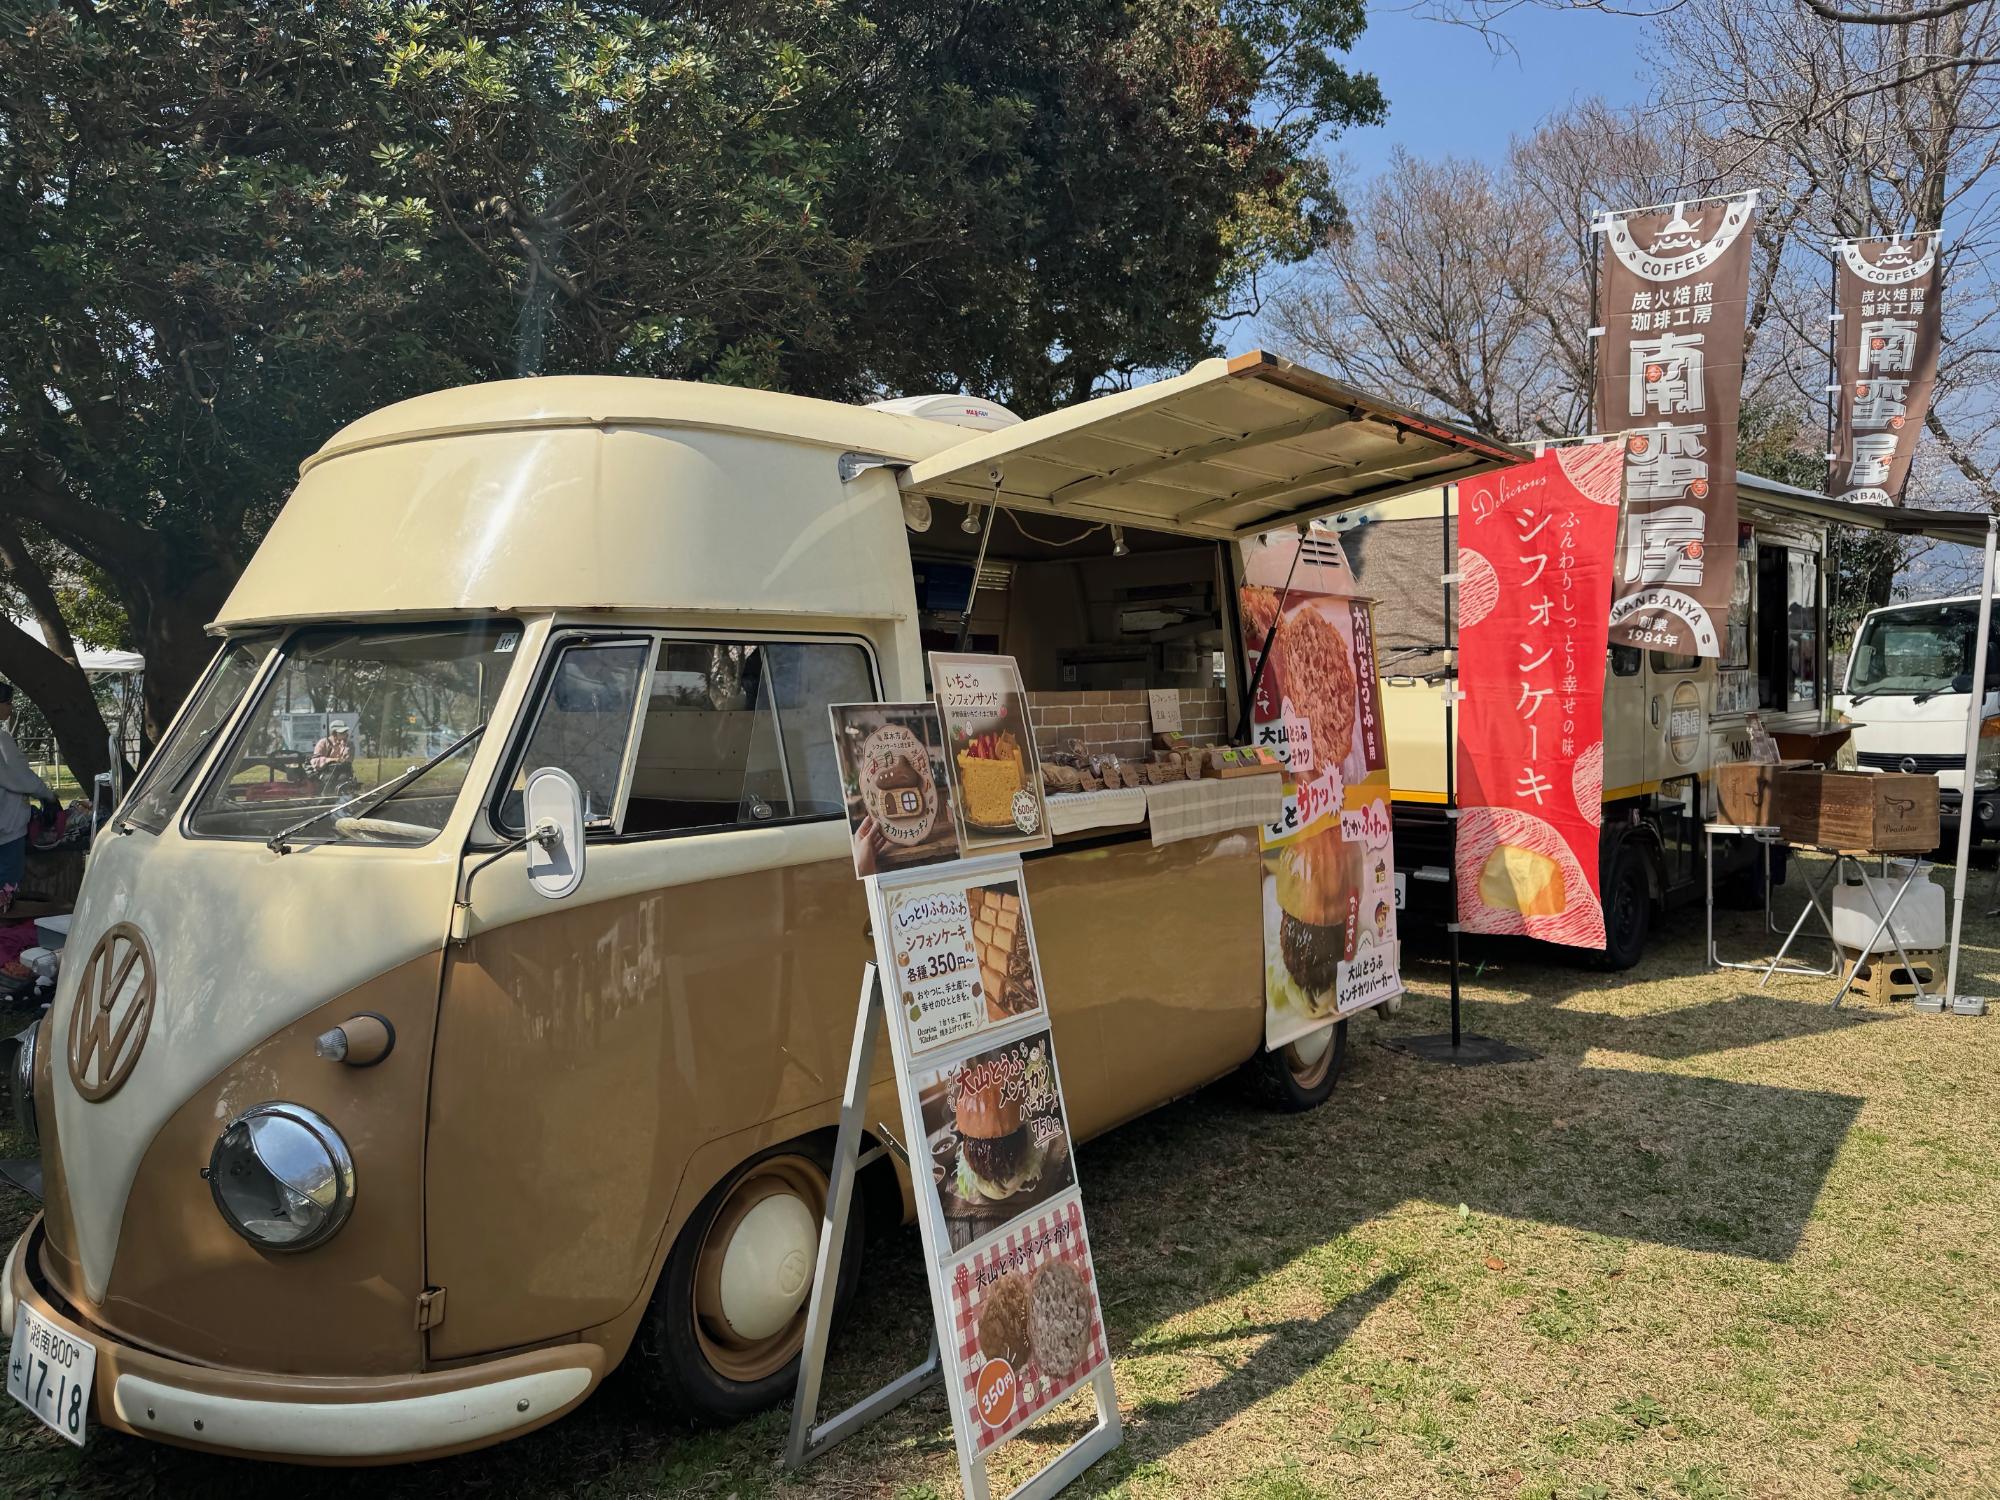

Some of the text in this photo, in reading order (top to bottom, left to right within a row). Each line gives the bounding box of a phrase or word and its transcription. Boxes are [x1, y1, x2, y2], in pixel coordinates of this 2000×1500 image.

[1641, 252, 1709, 276] COFFEE
[1867, 267, 1919, 281] COFFEE
[1631, 282, 1714, 311] 炭火焙煎
[1861, 287, 1925, 303] 炭火焙煎
[1631, 304, 1713, 332] 珈琲工房
[1861, 302, 1925, 317] 珈琲工房
[1847, 317, 1919, 487] 南蛮屋
[1624, 332, 1708, 587] 南蛮屋
[1471, 475, 1548, 525] Delicious
[1611, 594, 1702, 627] NANBANYA
[1638, 615, 1669, 632] 創業
[1559, 511, 1581, 758] ふんわりしっとり幸せの味
[1627, 629, 1679, 648] 1984年
[1515, 508, 1555, 806] シフォンケーキ
[946, 673, 979, 690] いちごの
[948, 692, 999, 707] シフォンサンド
[884, 818, 928, 840] オカリナキッチン
[898, 901, 968, 928] しっとりふわふわ
[905, 924, 967, 952] シフォンケーキ
[1346, 953, 1384, 983] 大山とうふ
[956, 1050, 1026, 1101] 大山とうふ
[999, 1065, 1049, 1109] メンチカツ
[1019, 1091, 1053, 1122] バーガー
[1032, 1117, 1060, 1140] 750円
[975, 1221, 1071, 1292] 大山とうふメンチカツ
[981, 1370, 1015, 1415] 350円
